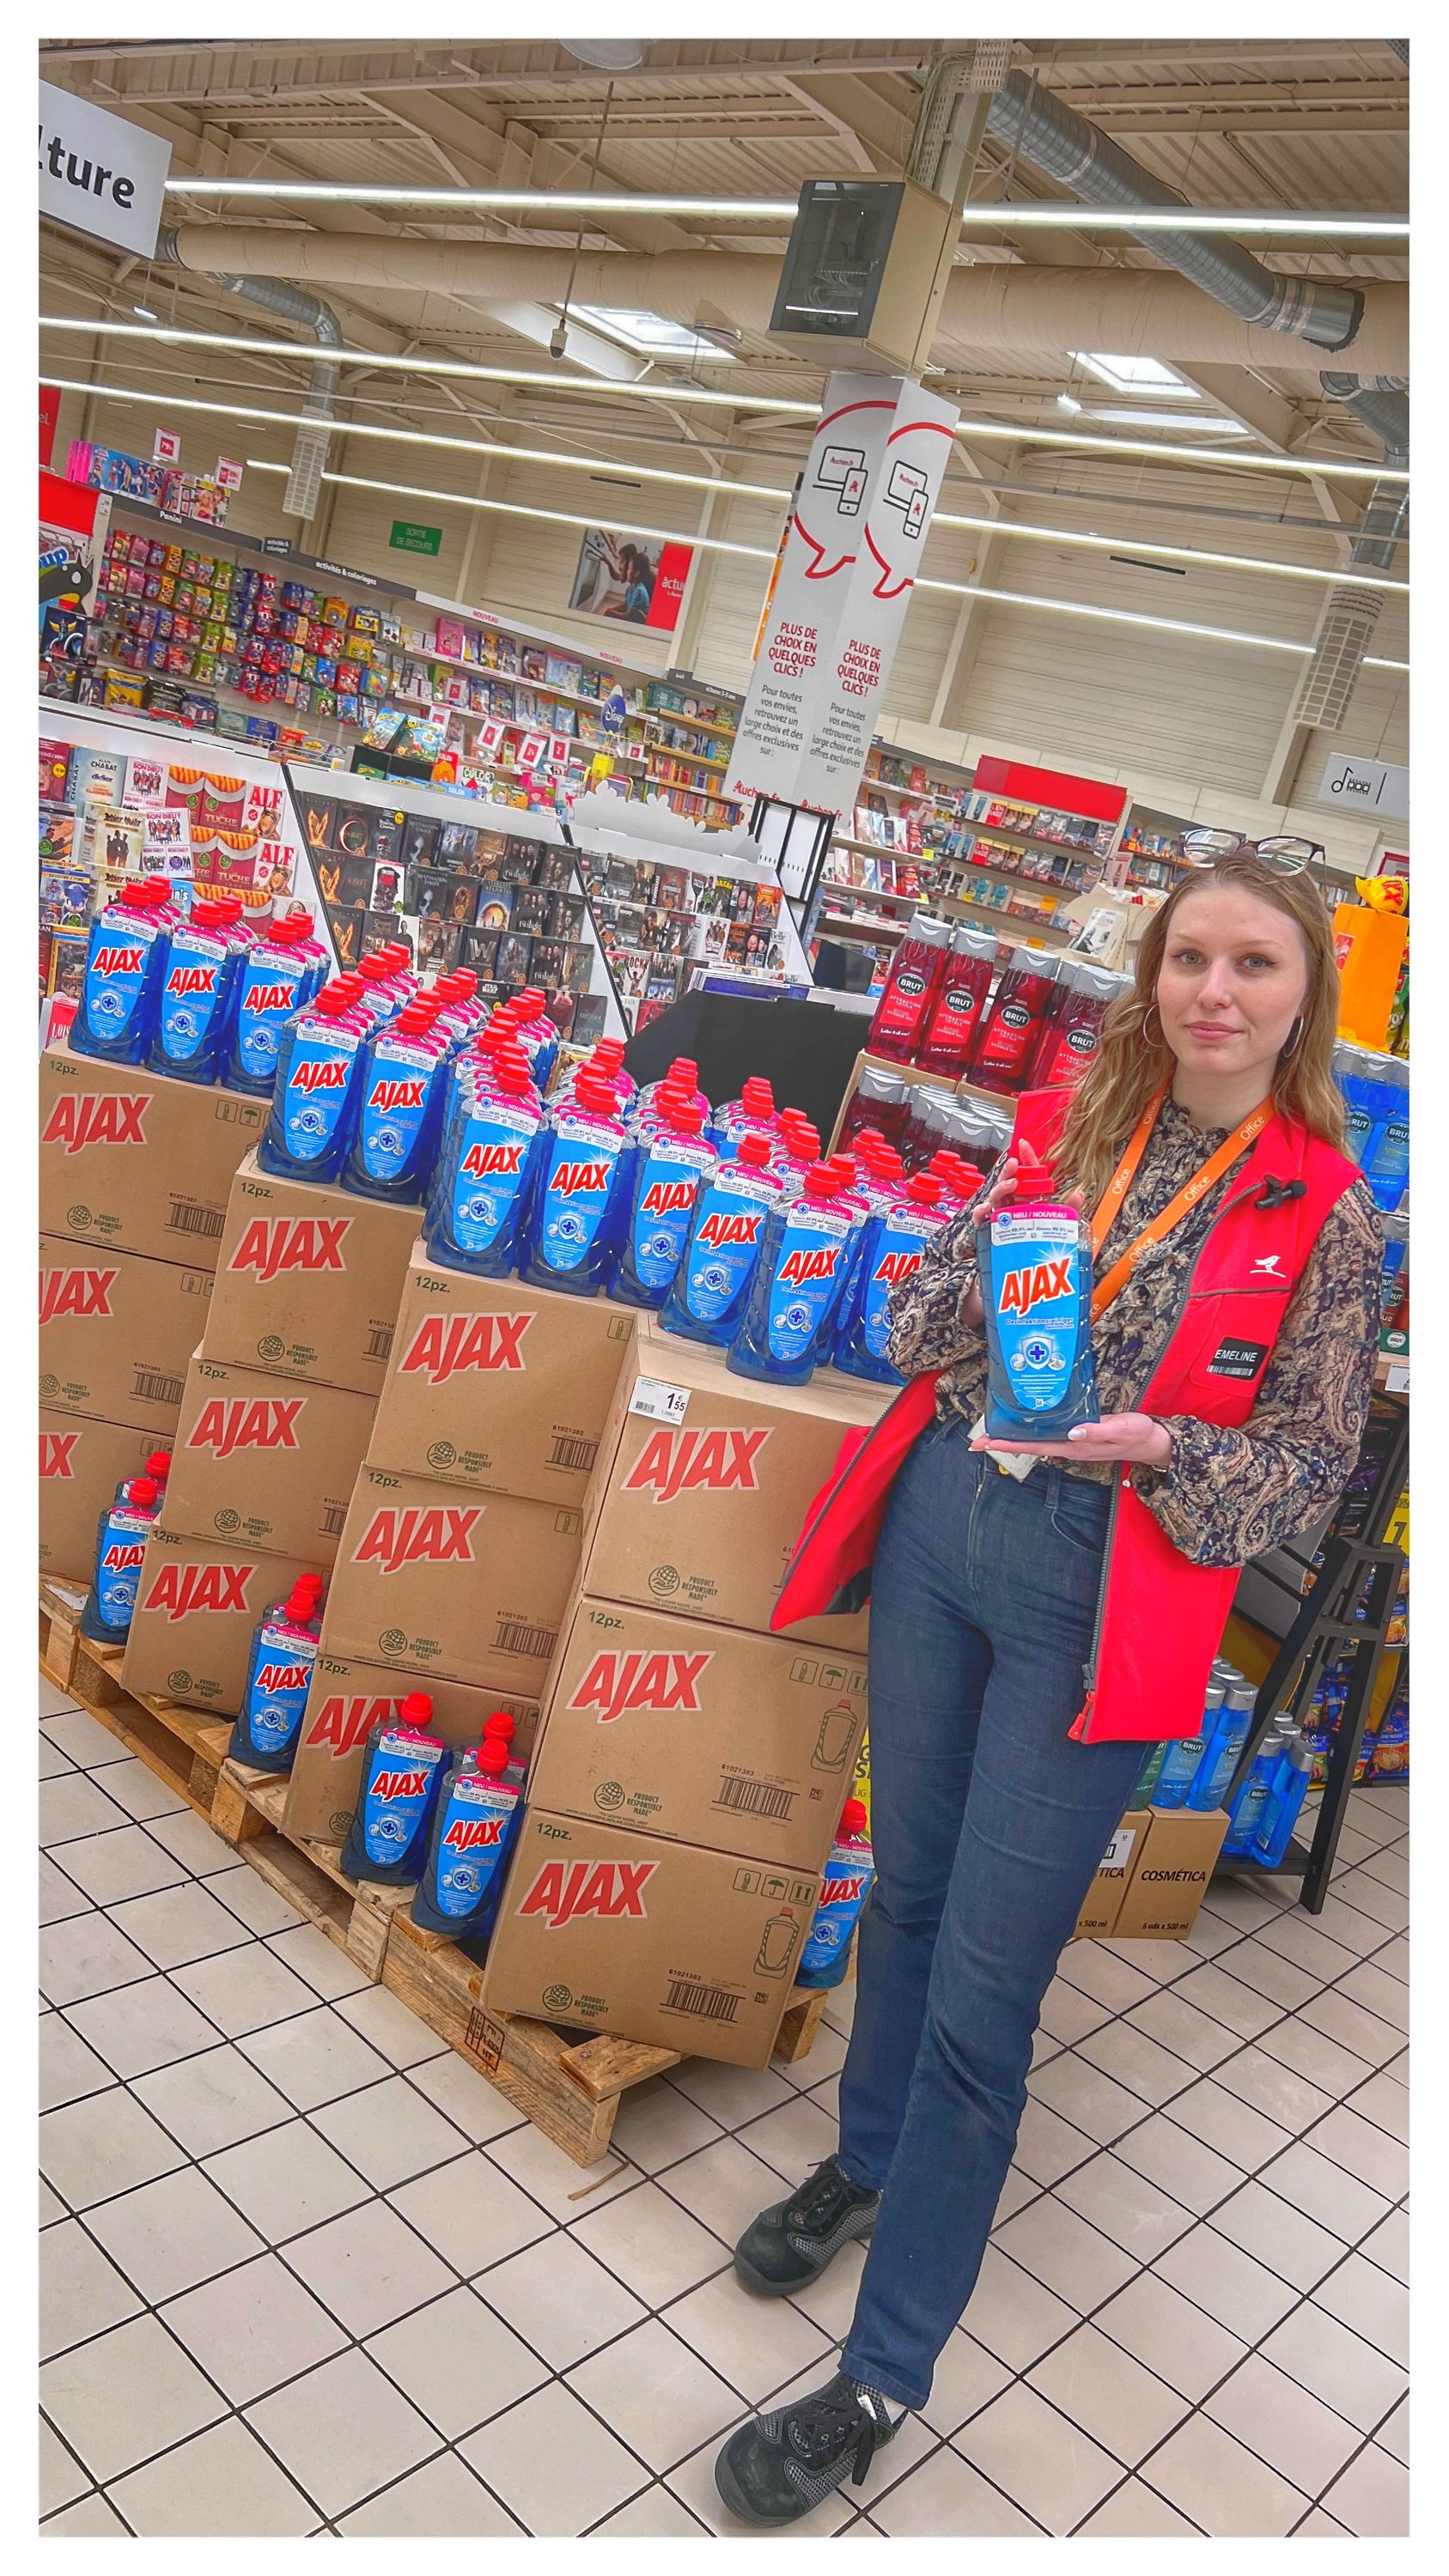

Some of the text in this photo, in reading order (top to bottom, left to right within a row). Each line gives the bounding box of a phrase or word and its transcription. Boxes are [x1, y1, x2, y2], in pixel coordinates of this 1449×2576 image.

[160, 510, 182, 524] Panini
[406, 527, 427, 538] SORTIE
[396, 537, 433, 551] DE SECOURS
[316, 561, 341, 574] activités
[347, 570, 377, 586] coloriages
[473, 611, 499, 624] NOUVEAU
[781, 623, 818, 639] PLUS DE
[775, 635, 817, 653] CHOIX EN
[849, 641, 881, 659] PLUS DE
[599, 652, 623, 664] NOUVEAU
[769, 647, 816, 666] QUELQUES
[843, 653, 880, 673] CHOIX EN
[774, 663, 798, 677] CLICS
[837, 665, 879, 687] QUELQUES
[762, 685, 802, 702] Pour toutes
[843, 681, 863, 696] CLICS
[761, 697, 797, 714] vos envies,
[831, 702, 866, 720] Pour toutes
[755, 708, 787, 723] retrouvez
[829, 716, 839, 726] vos
[745, 718, 762, 731] large
[763, 721, 781, 734] choix
[790, 729, 803, 740] des
[822, 727, 861, 744] retrouvez un
[743, 730, 799, 751] offres exclusives
[813, 735, 865, 757] large choix et des
[91, 762, 117, 771] CHABAT
[133, 762, 147, 771] BON
[810, 748, 860, 768] offres exclusives
[70, 764, 79, 800] CHABAT
[464, 767, 491, 783] COLOR
[248, 786, 283, 810] ALF
[447, 787, 466, 796] COLOR
[204, 813, 238, 827] TUCHE
[259, 842, 294, 866] ALF
[217, 872, 250, 884] TUCHE
[166, 967, 216, 997] AJAX
[900, 979, 922, 991] BRUT
[243, 985, 295, 1014] AJAX
[949, 996, 971, 1007] BRUT
[1005, 1012, 1027, 1023] BRUT
[1071, 1036, 1093, 1047] BRUT
[49, 1060, 79, 1076] 12pz.
[289, 1060, 350, 1093] AJAX
[367, 1080, 427, 1113] AJAX
[41, 1094, 154, 1155] AJAX
[1239, 1115, 1265, 1142] Office
[460, 1144, 526, 1180] AJAX
[549, 1163, 612, 1198] AJAX
[752, 1175, 777, 1188] NOUVEAU
[1111, 1167, 1130, 1195] Office
[1184, 1174, 1211, 1203] Office
[241, 1182, 273, 1199] 12pz.
[640, 1182, 697, 1217] AJAX
[825, 1207, 848, 1218] NOUVEAU
[696, 1213, 764, 1248] AJAX
[226, 1217, 356, 1284] AJAX
[1129, 1235, 1155, 1263] Office
[776, 1248, 843, 1287] AJAX
[415, 1275, 450, 1293] 12pz.
[999, 1258, 1075, 1316] AJAX
[396, 1311, 538, 1385] AJAX
[1215, 1348, 1258, 1363] EMELINE
[198, 1364, 229, 1380] 12pz.
[674, 1400, 685, 1412] 55
[186, 1398, 308, 1460] AJAX
[620, 1426, 776, 1504] AJAX
[368, 1472, 402, 1488] 12pz.
[152, 1528, 182, 1545] 12pz.
[350, 1506, 487, 1575] AJAX
[681, 1582, 718, 1596] RESPONSIBLY
[689, 1575, 715, 1588] PRODUCT
[141, 1564, 259, 1623] AJAX
[588, 1611, 625, 1630] 12pz.
[318, 1658, 350, 1675] 12pz.
[256, 1665, 310, 1692] AJAX
[565, 1649, 715, 1724] AJAX
[1182, 1741, 1203, 1752] BRUT
[634, 1792, 659, 1804] PRODUCT
[1251, 1789, 1269, 1800] BRUT
[626, 1798, 663, 1812] RESPONSIBLY
[443, 1819, 505, 1851] AJAX
[536, 1822, 572, 1842] 12pz.
[1141, 1868, 1206, 1882] COSMÉTICA
[515, 1858, 661, 1929] AJAX
[1099, 1920, 1107, 1929] ml
[574, 1999, 609, 2014] RESPONSIBLY
[581, 1993, 606, 2005] PRODUCT
